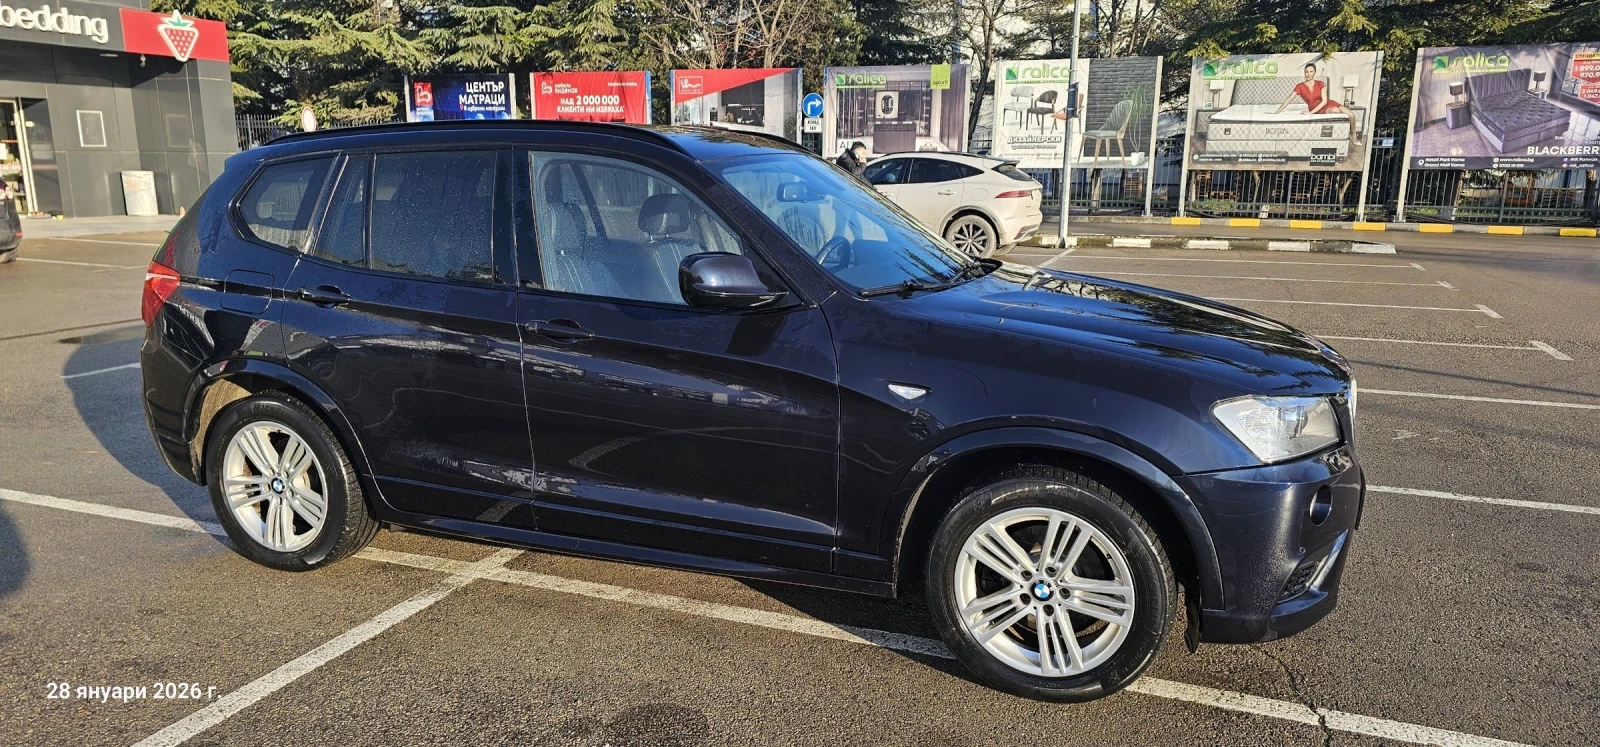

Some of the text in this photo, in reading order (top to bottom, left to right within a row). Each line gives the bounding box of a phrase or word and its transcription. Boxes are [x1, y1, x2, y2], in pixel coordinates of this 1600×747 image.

[1222, 58, 1278, 74] ralica
[1452, 52, 1510, 68] ralica
[1022, 62, 1070, 78] ralica
[849, 71, 887, 84] ralica
[466, 82, 504, 94] ЦЕНТЪР
[459, 94, 505, 106] МАТРАЦИ
[576, 95, 582, 105] 2
[583, 95, 600, 104] 000
[602, 95, 619, 104] 000
[1007, 135, 1062, 144] ДИЗАЙНЕРСКИ
[1527, 146, 1600, 154] BLACKBERR
